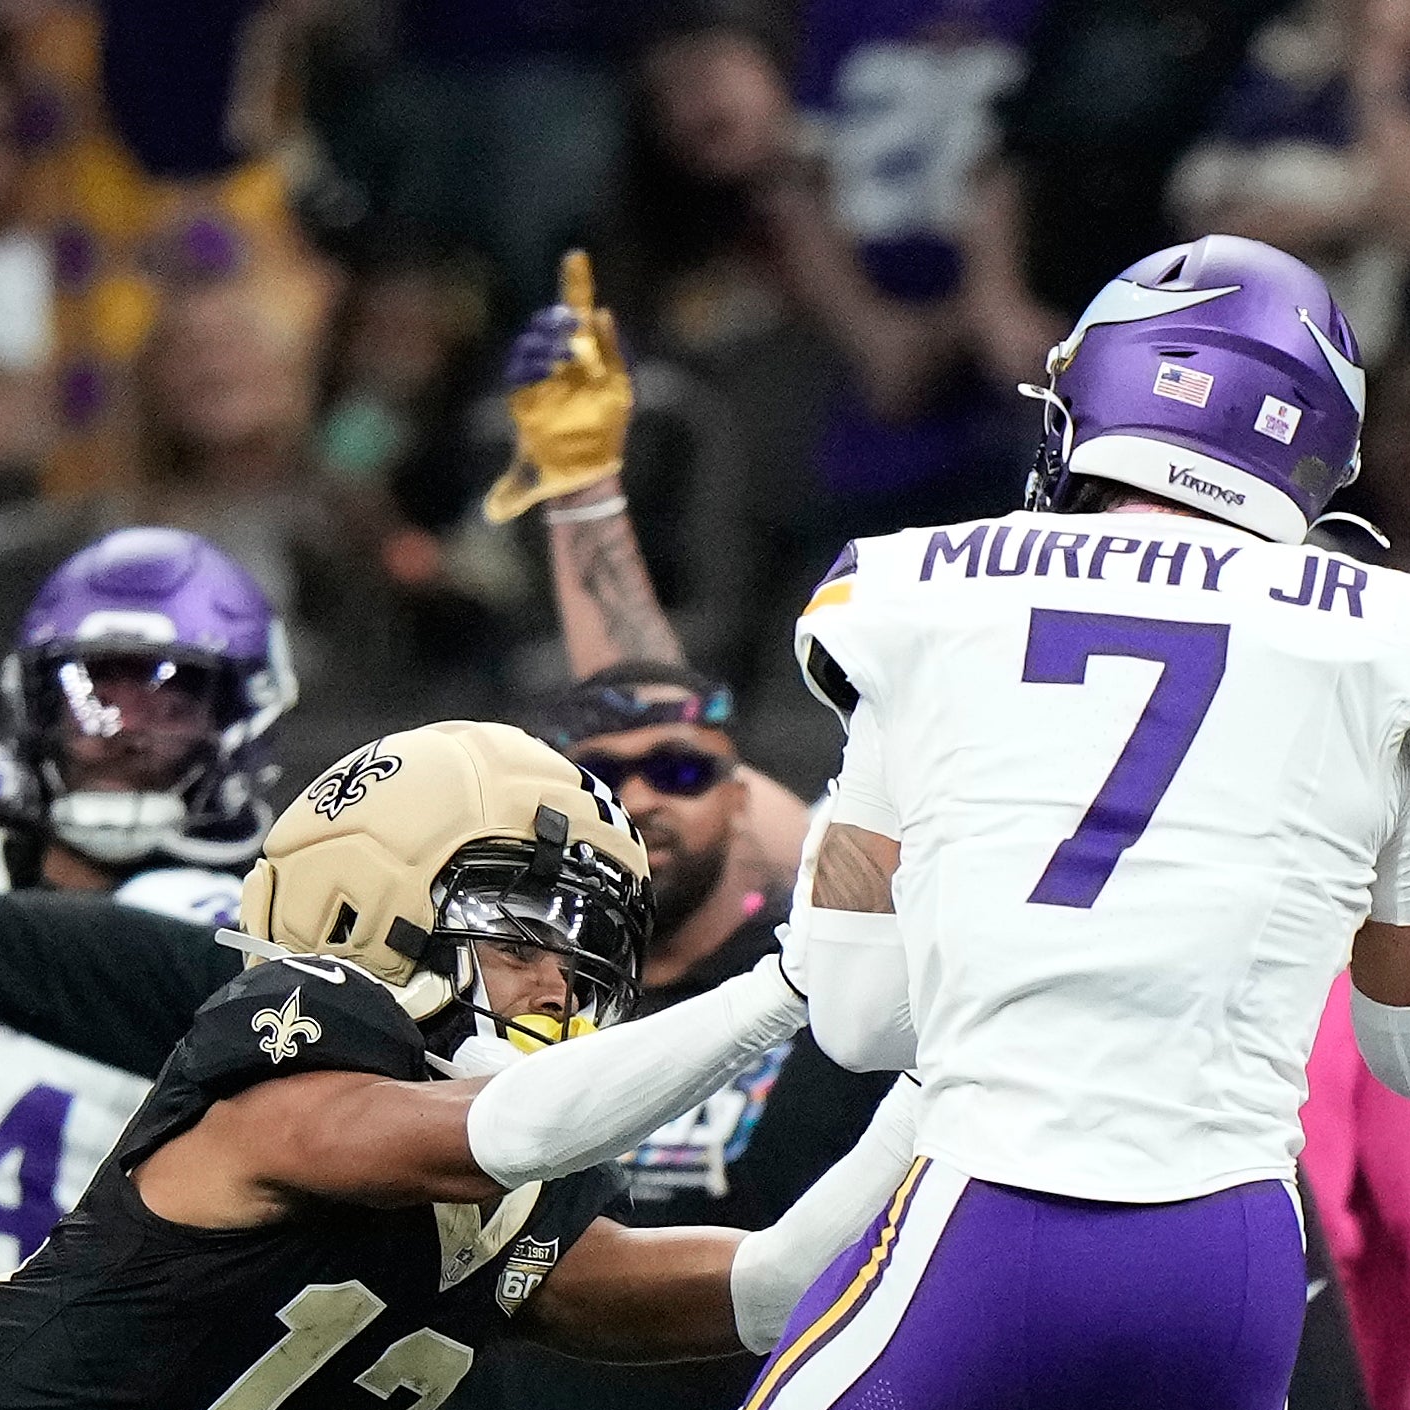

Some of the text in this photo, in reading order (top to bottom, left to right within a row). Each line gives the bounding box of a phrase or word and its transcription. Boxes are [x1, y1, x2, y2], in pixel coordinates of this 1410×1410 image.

[919, 524, 1368, 619] MURPHY JR
[1021, 607, 1231, 909] 7
[527, 1245, 550, 1259] 1967
